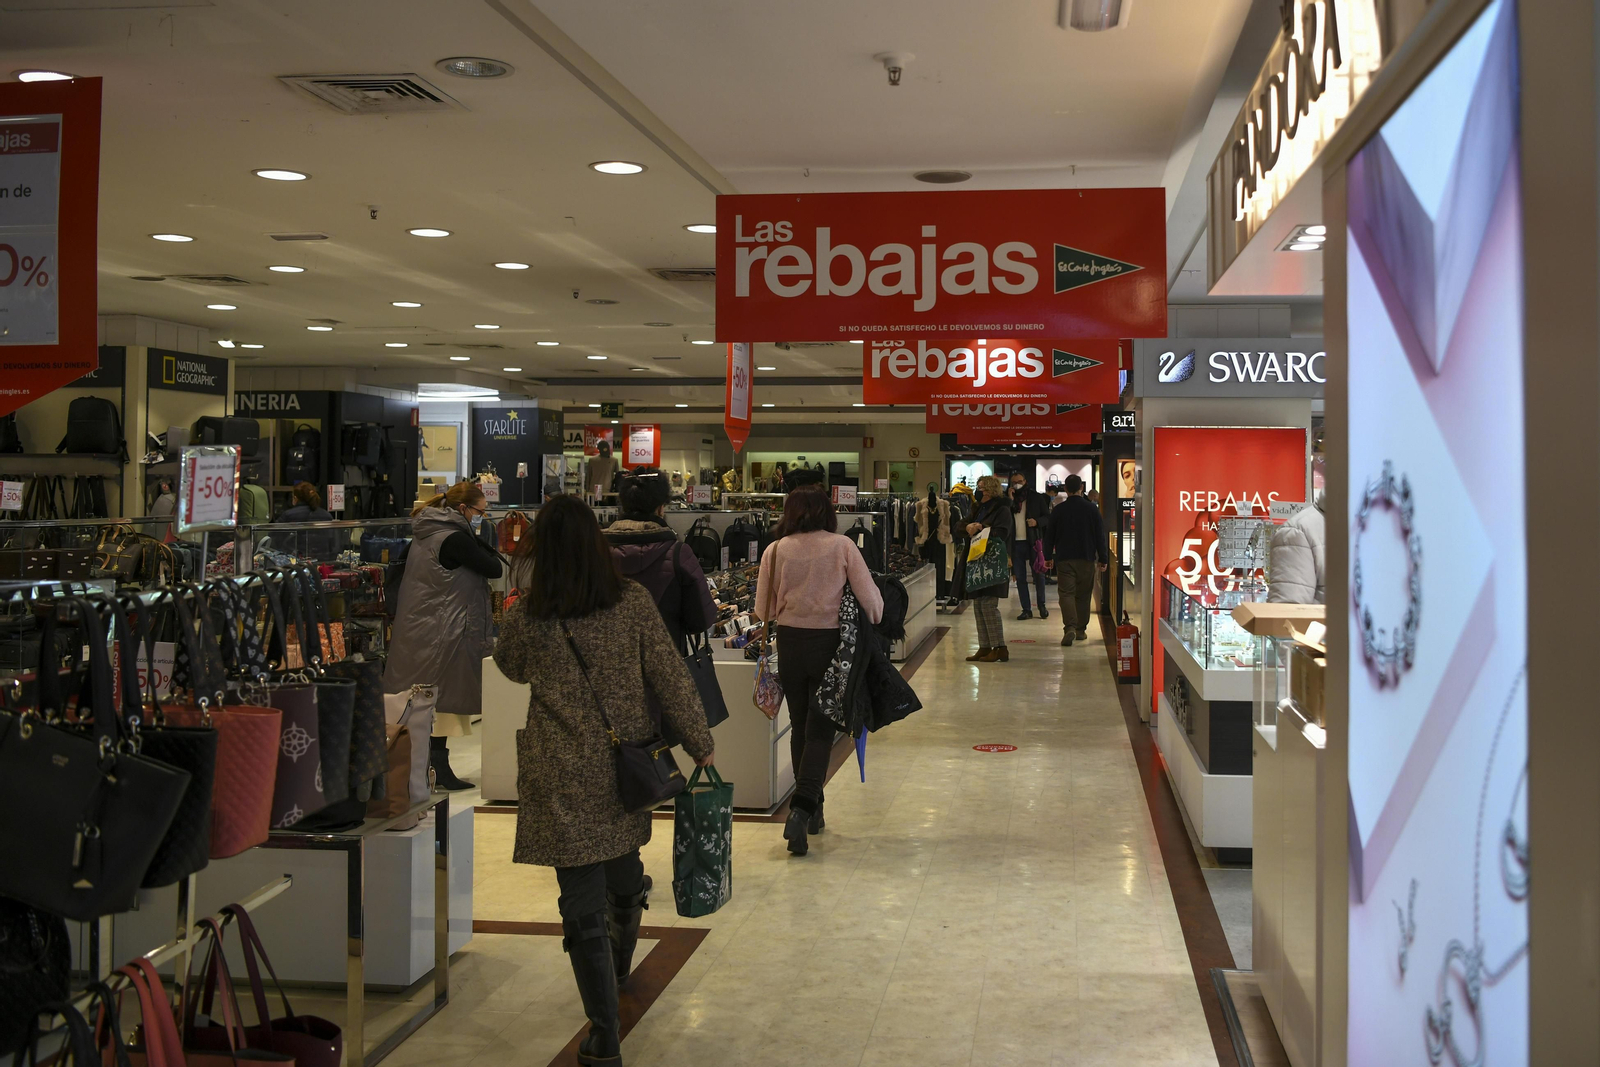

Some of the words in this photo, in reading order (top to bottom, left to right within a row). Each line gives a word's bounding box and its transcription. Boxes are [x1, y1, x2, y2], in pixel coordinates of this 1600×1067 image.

[13, 184, 32, 198] de
[735, 214, 794, 243] Las
[735, 225, 1039, 312] rebajas
[1058, 261, 1067, 272] El
[1068, 262, 1090, 272] Corte
[1090, 260, 1122, 276] Inglés
[176, 360, 207, 374] NATIONAL
[871, 339, 1044, 388] rebajas
[176, 372, 215, 386] GEOGRAPHIC
[484, 419, 527, 435] STARLITE
[631, 448, 652, 457] -50%
[198, 475, 233, 499] -50%
[1272, 506, 1292, 514] vidal
